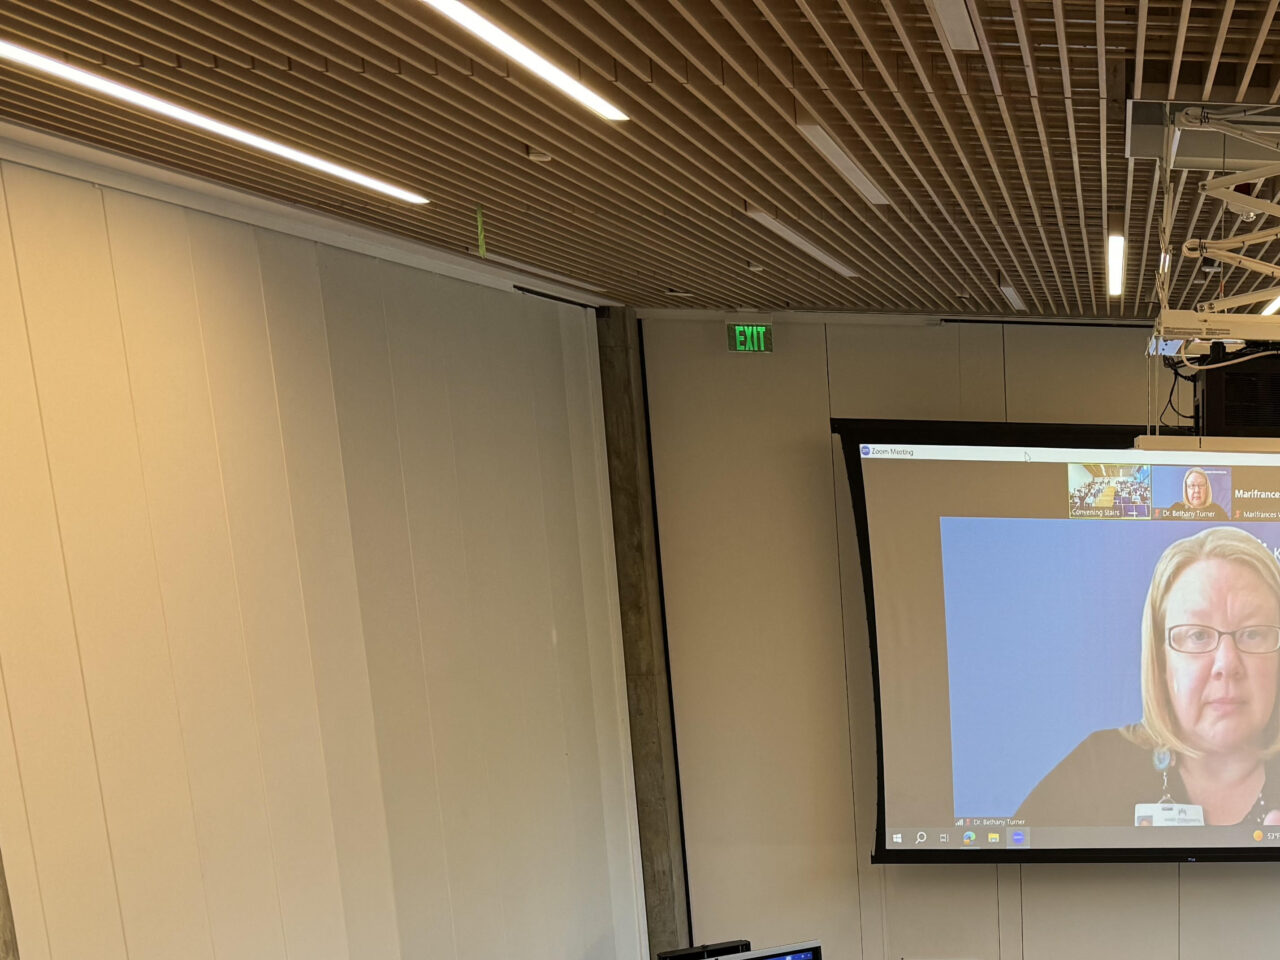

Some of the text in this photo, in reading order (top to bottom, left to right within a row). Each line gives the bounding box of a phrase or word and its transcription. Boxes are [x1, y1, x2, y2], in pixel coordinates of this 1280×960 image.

[735, 325, 766, 351] EXIT
[871, 447, 914, 457] Zoom Meeting
[1071, 508, 1120, 517] Convening Stairs
[1172, 510, 1195, 518] Bethany
[1243, 510, 1277, 518] Marifrances
[983, 818, 1005, 827] Bethany
[1006, 818, 1025, 826] Turner
